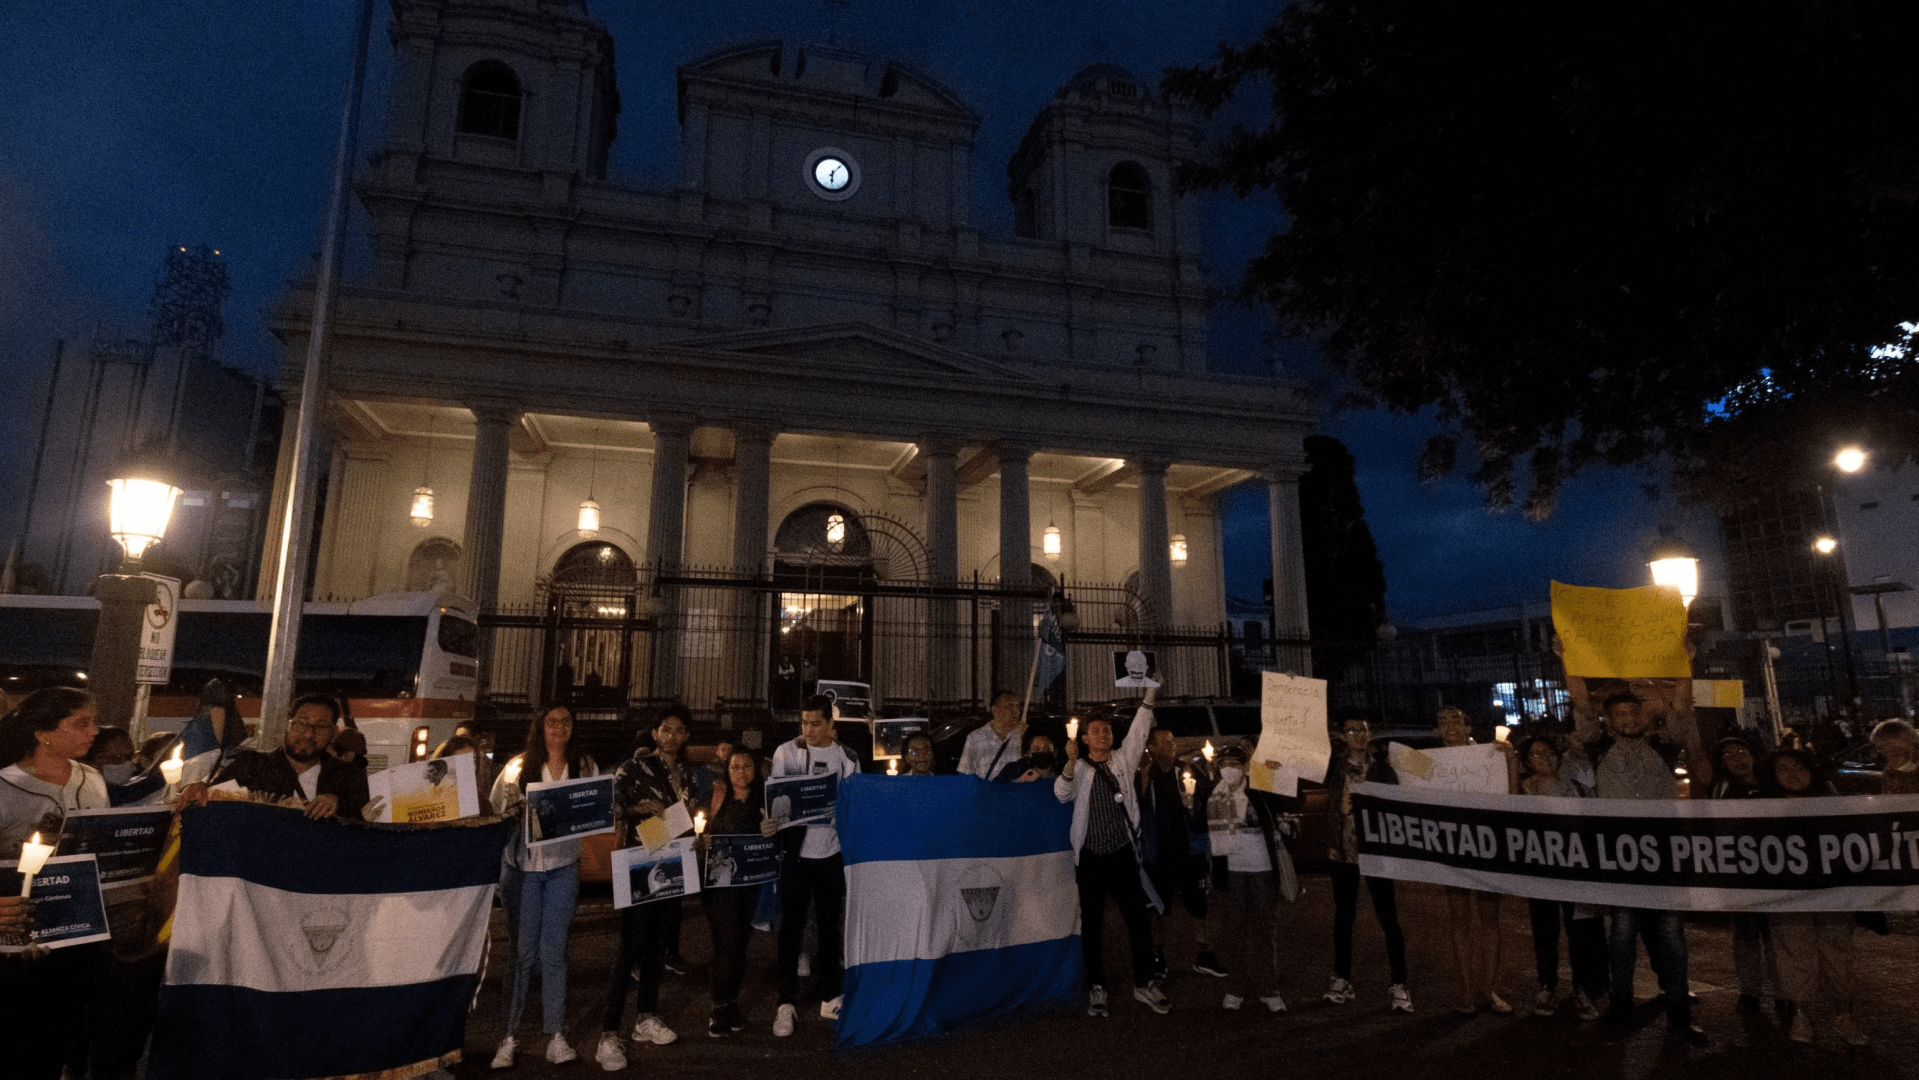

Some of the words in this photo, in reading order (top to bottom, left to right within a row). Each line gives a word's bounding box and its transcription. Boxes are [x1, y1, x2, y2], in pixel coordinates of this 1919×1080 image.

[800, 784, 828, 792] LIBERTAD
[569, 789, 598, 800] LIBERTAD
[115, 827, 155, 838] LIBERTAD
[743, 842, 774, 851] LIBERTAD
[1361, 808, 1498, 860] LIBERTAD
[1505, 827, 1590, 870] PARA
[1596, 832, 1661, 873] LOS
[1669, 834, 1809, 875] PRESOS
[32, 875, 70, 887] BERTAD
